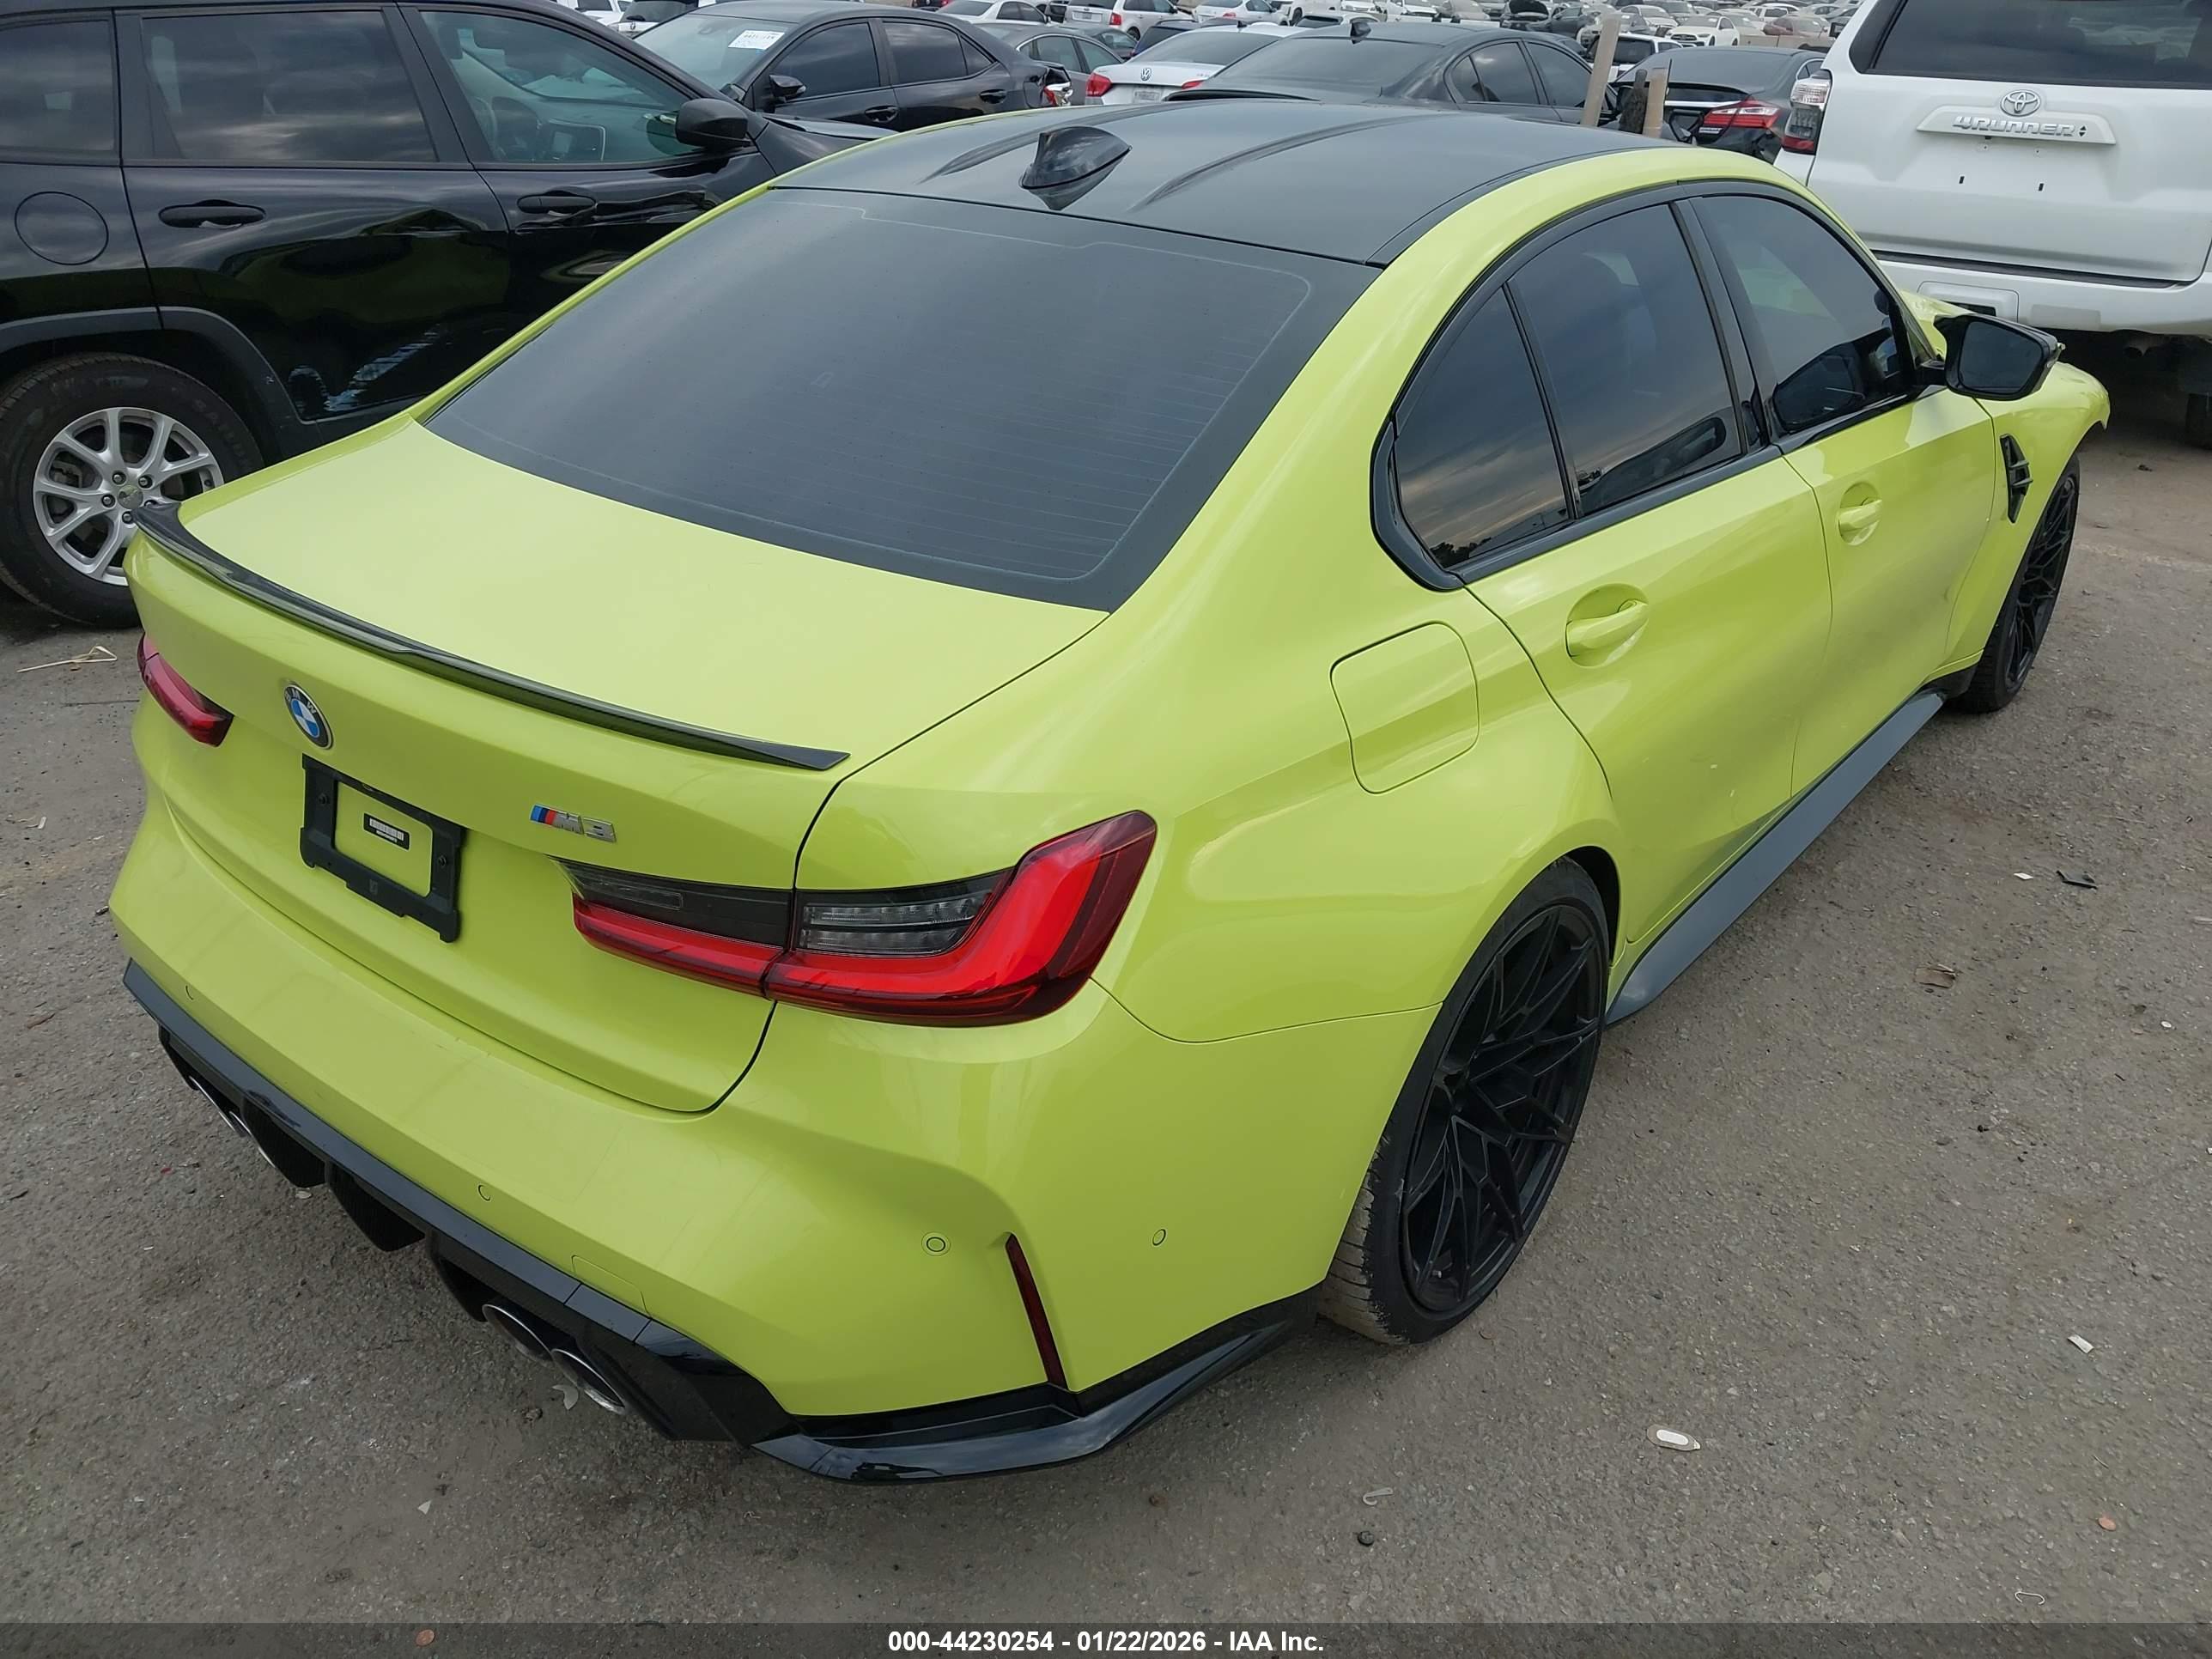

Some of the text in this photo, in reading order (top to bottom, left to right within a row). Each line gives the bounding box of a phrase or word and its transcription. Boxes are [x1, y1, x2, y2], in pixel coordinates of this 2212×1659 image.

[1953, 116, 2075, 137] 4RUNNER
[284, 687, 317, 714] BMW
[550, 811, 617, 842] M3
